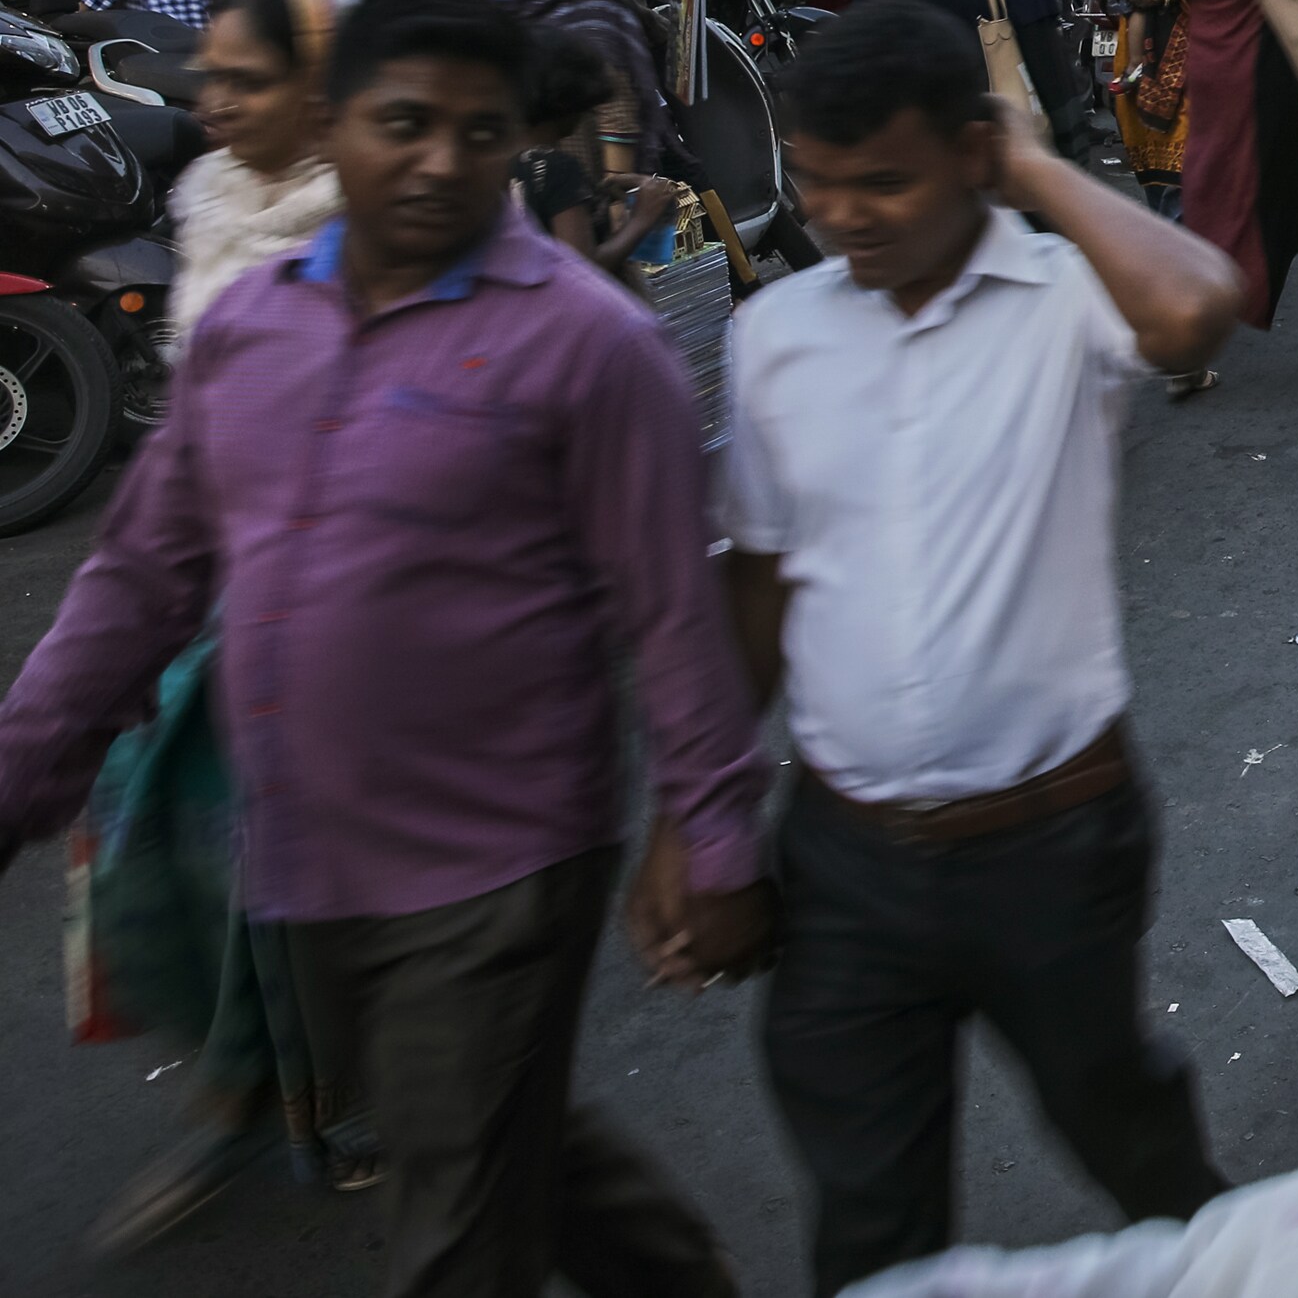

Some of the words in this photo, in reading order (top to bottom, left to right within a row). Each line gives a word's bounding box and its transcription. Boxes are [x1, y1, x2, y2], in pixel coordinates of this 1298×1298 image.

[46, 97, 70, 117] WB
[69, 95, 89, 109] 06
[54, 108, 103, 131] P1493
